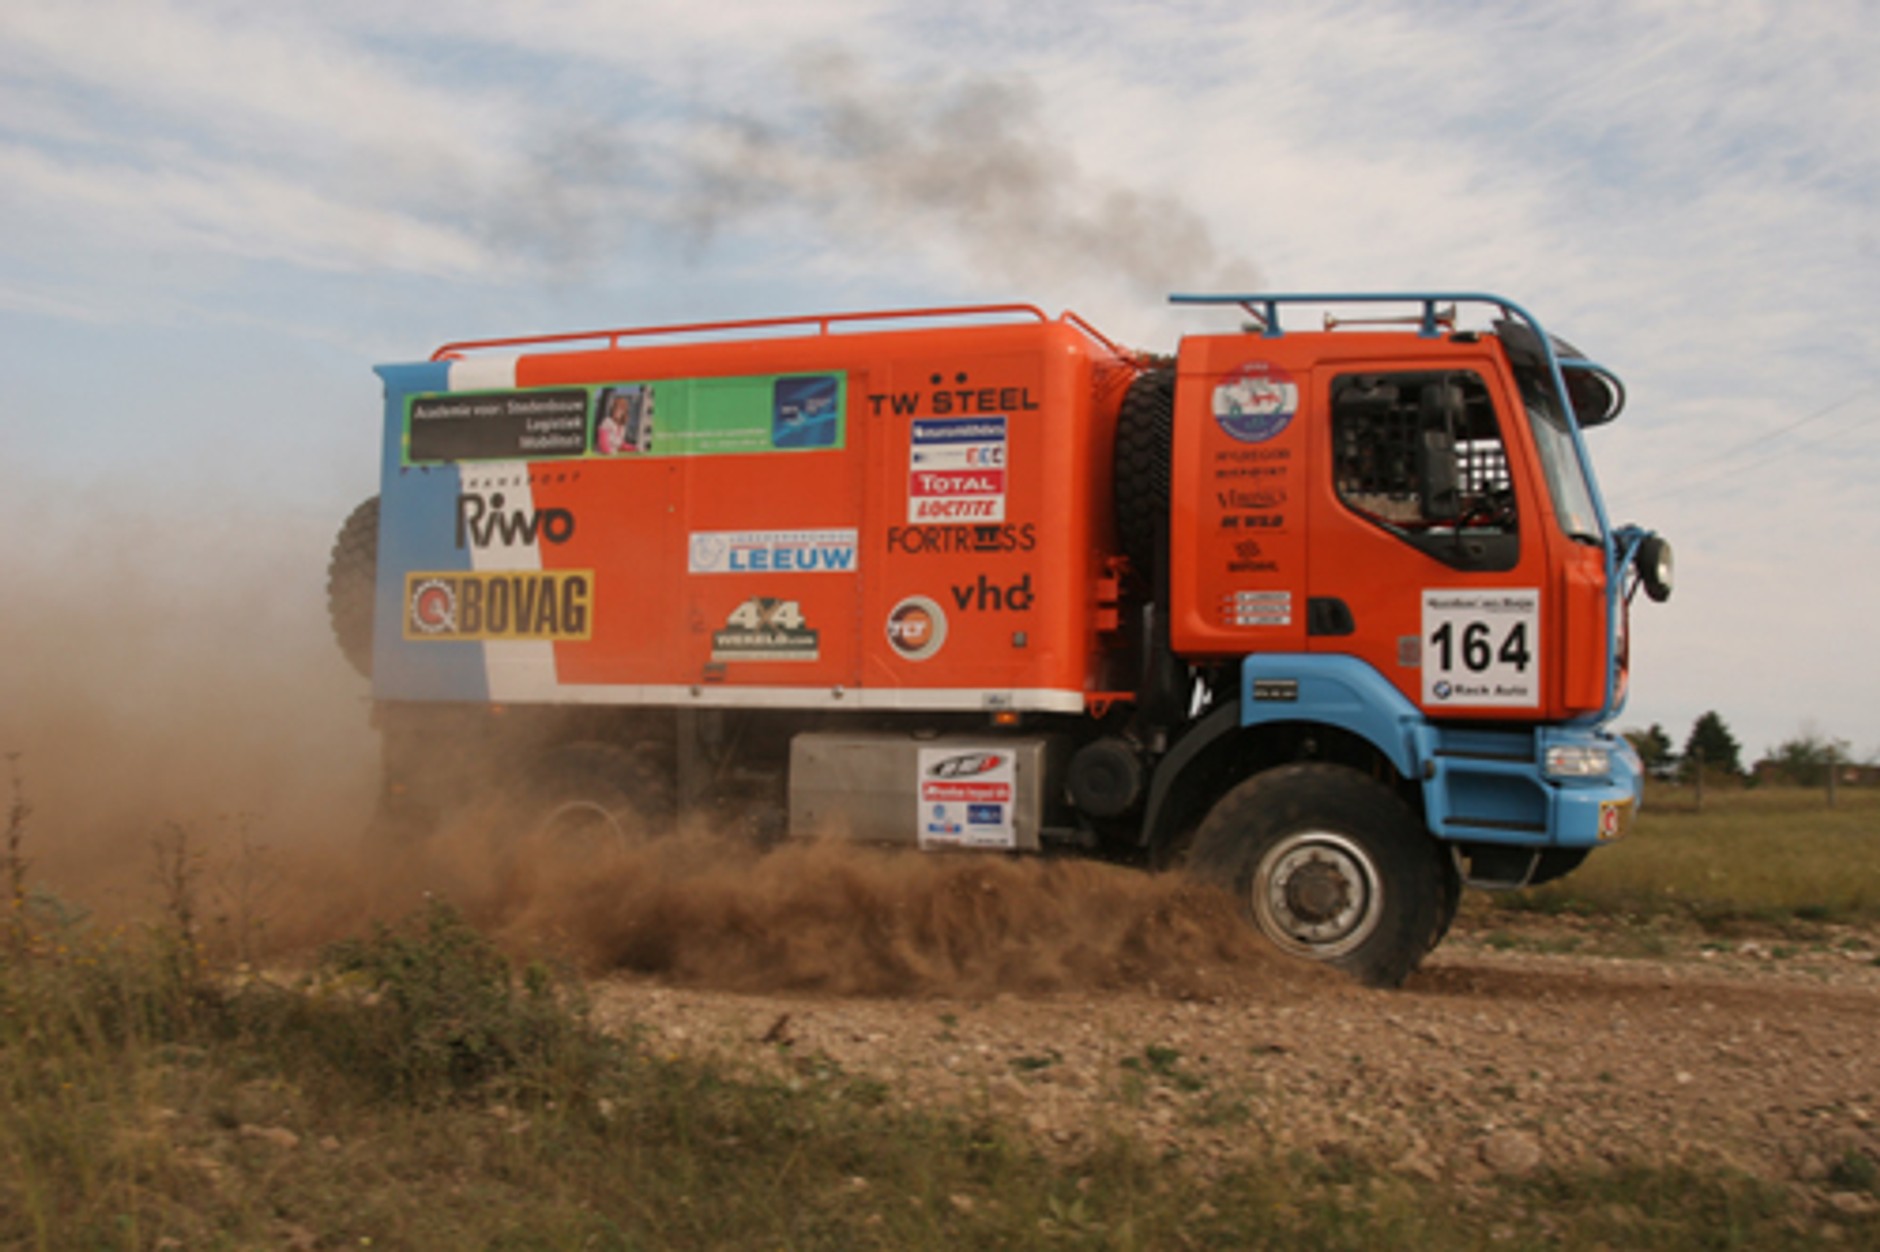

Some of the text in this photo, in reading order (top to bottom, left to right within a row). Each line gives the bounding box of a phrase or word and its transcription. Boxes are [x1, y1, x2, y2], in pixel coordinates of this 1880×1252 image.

[867, 387, 1039, 416] TW STEEL
[455, 492, 577, 550] Riwo
[917, 499, 996, 517] LOCTITE
[728, 546, 853, 571] LEEUW
[458, 575, 588, 635] BOVAG
[951, 573, 1035, 611] vhd
[1429, 620, 1531, 674] 164
